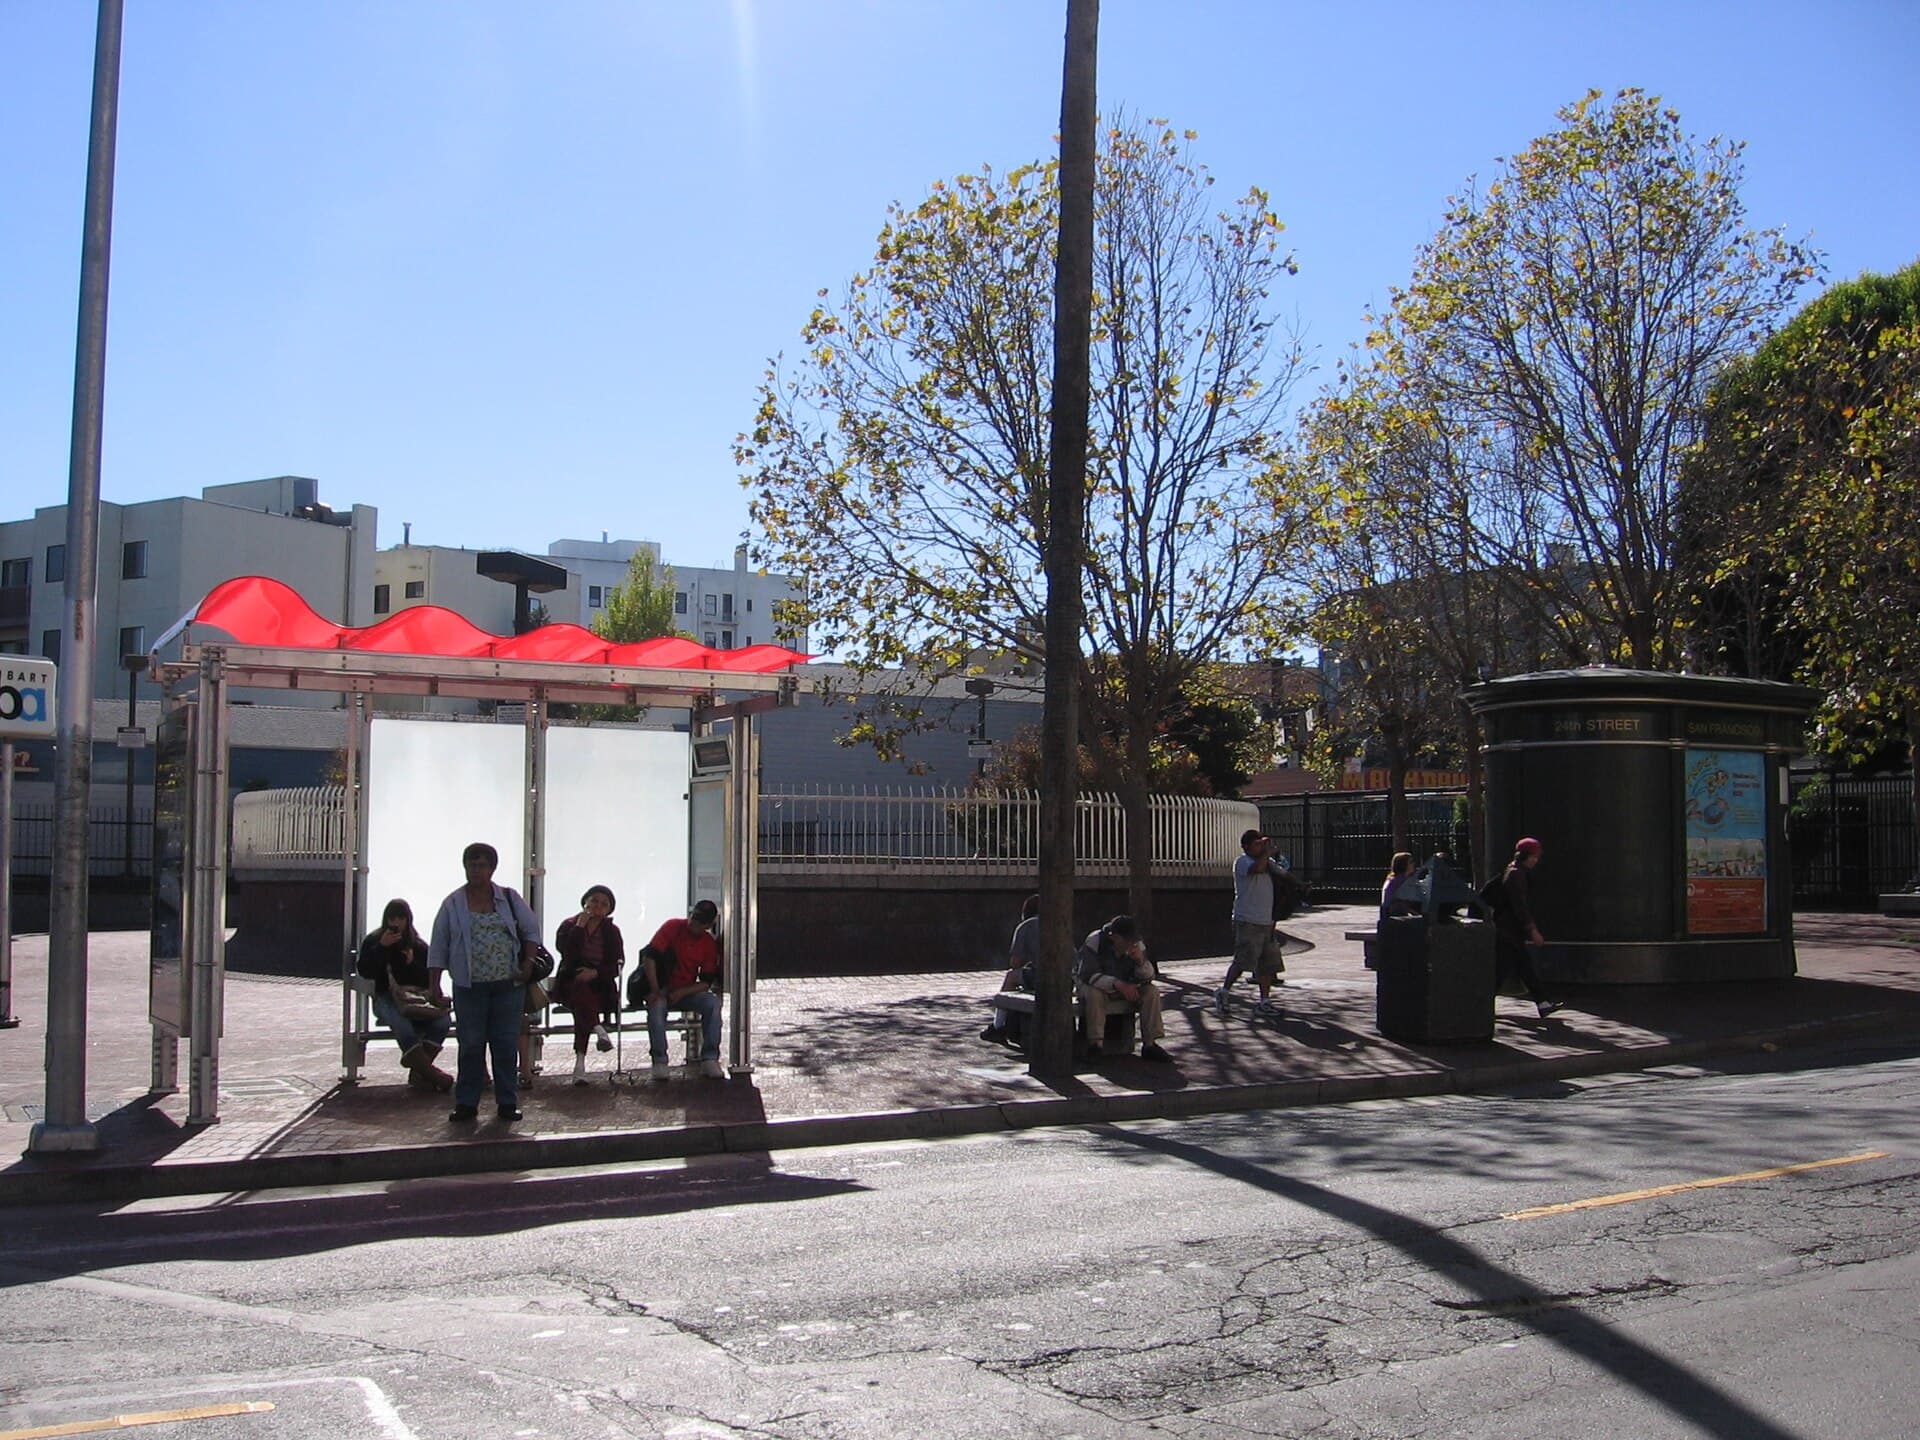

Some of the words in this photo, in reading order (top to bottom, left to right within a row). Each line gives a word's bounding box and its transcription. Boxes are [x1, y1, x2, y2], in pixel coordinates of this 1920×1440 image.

[7, 670, 48, 684] BART
[1554, 719, 1581, 732] 24th
[1586, 719, 1640, 731] STREET
